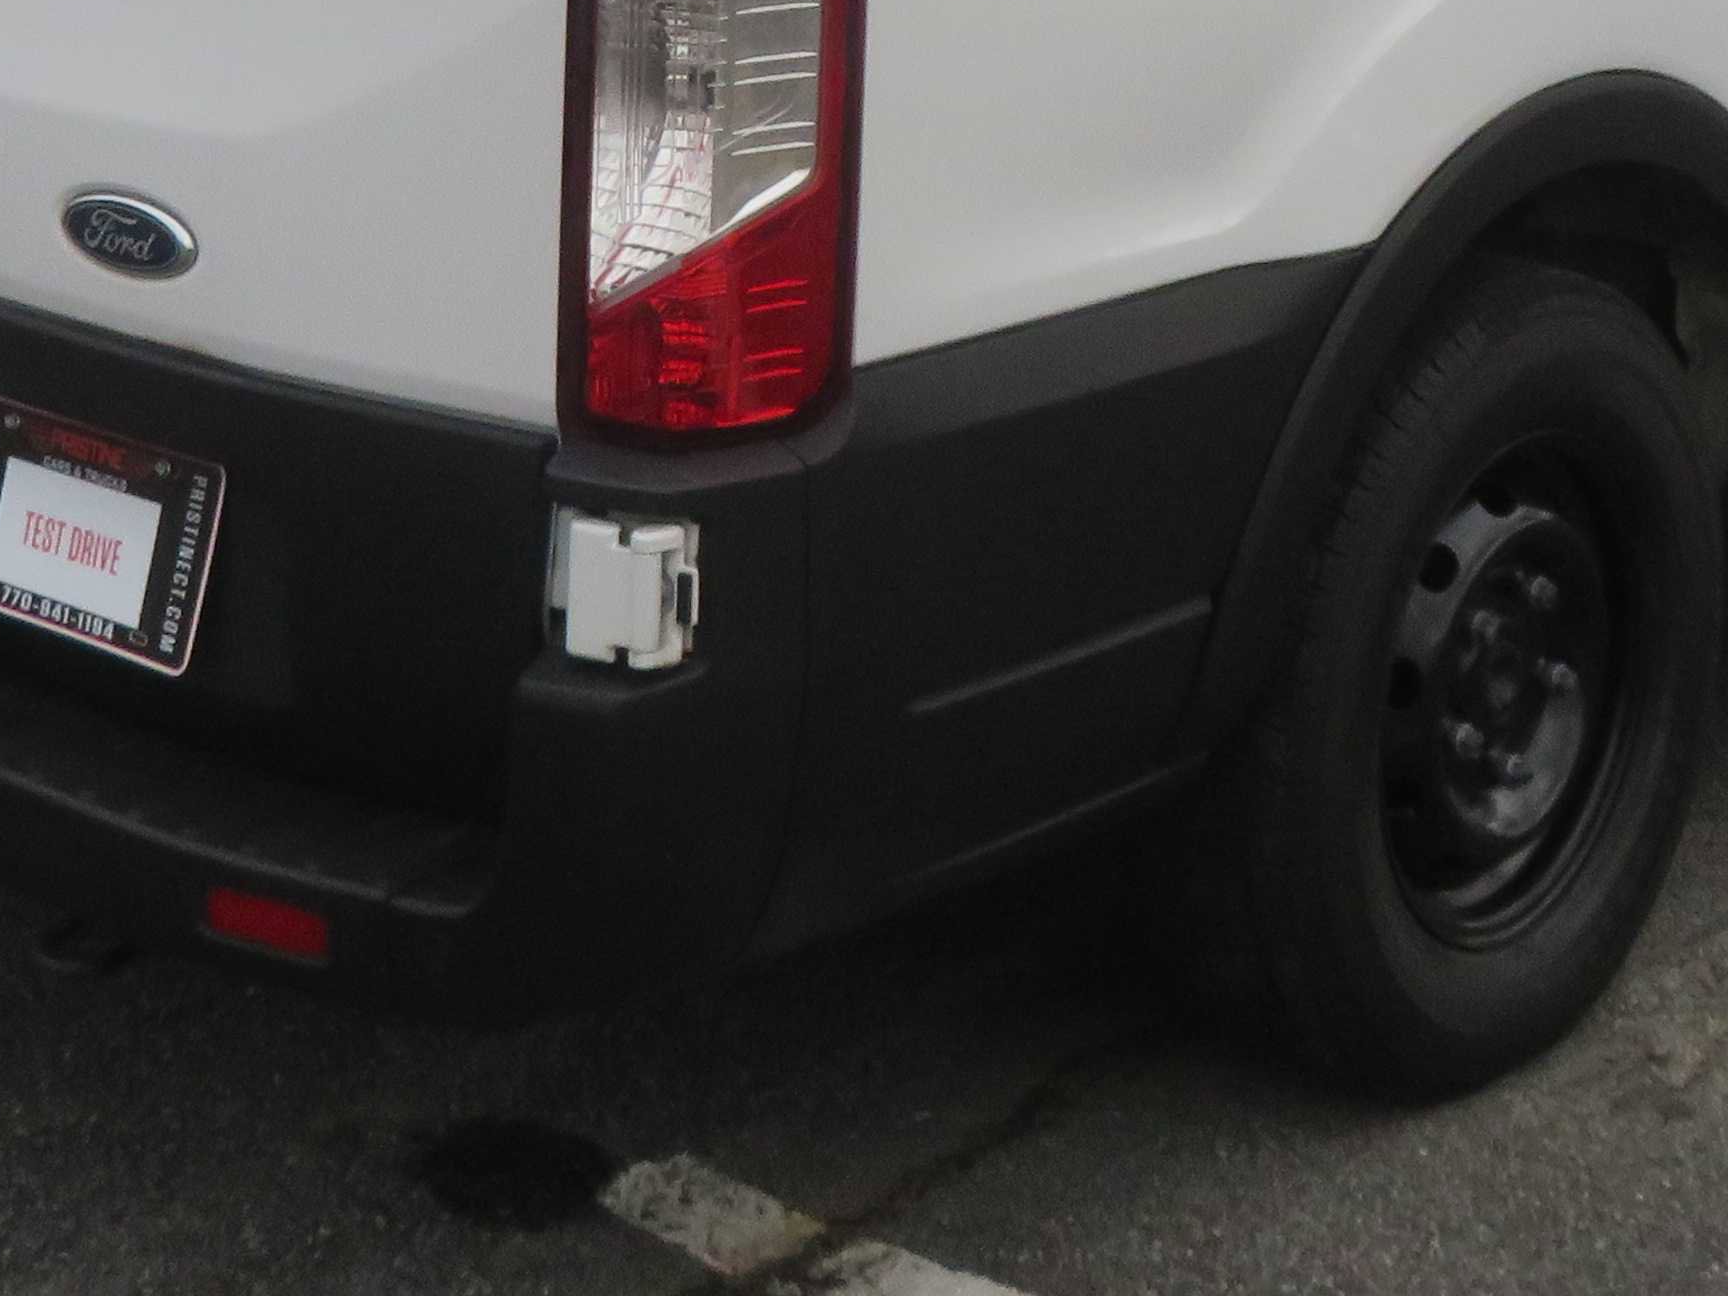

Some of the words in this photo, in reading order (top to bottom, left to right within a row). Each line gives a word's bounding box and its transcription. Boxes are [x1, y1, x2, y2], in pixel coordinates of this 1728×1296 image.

[83, 208, 157, 261] Ford
[23, 510, 66, 556] TEST
[68, 525, 123, 577] DRIVE
[159, 475, 209, 654] PRISTINECT.COM
